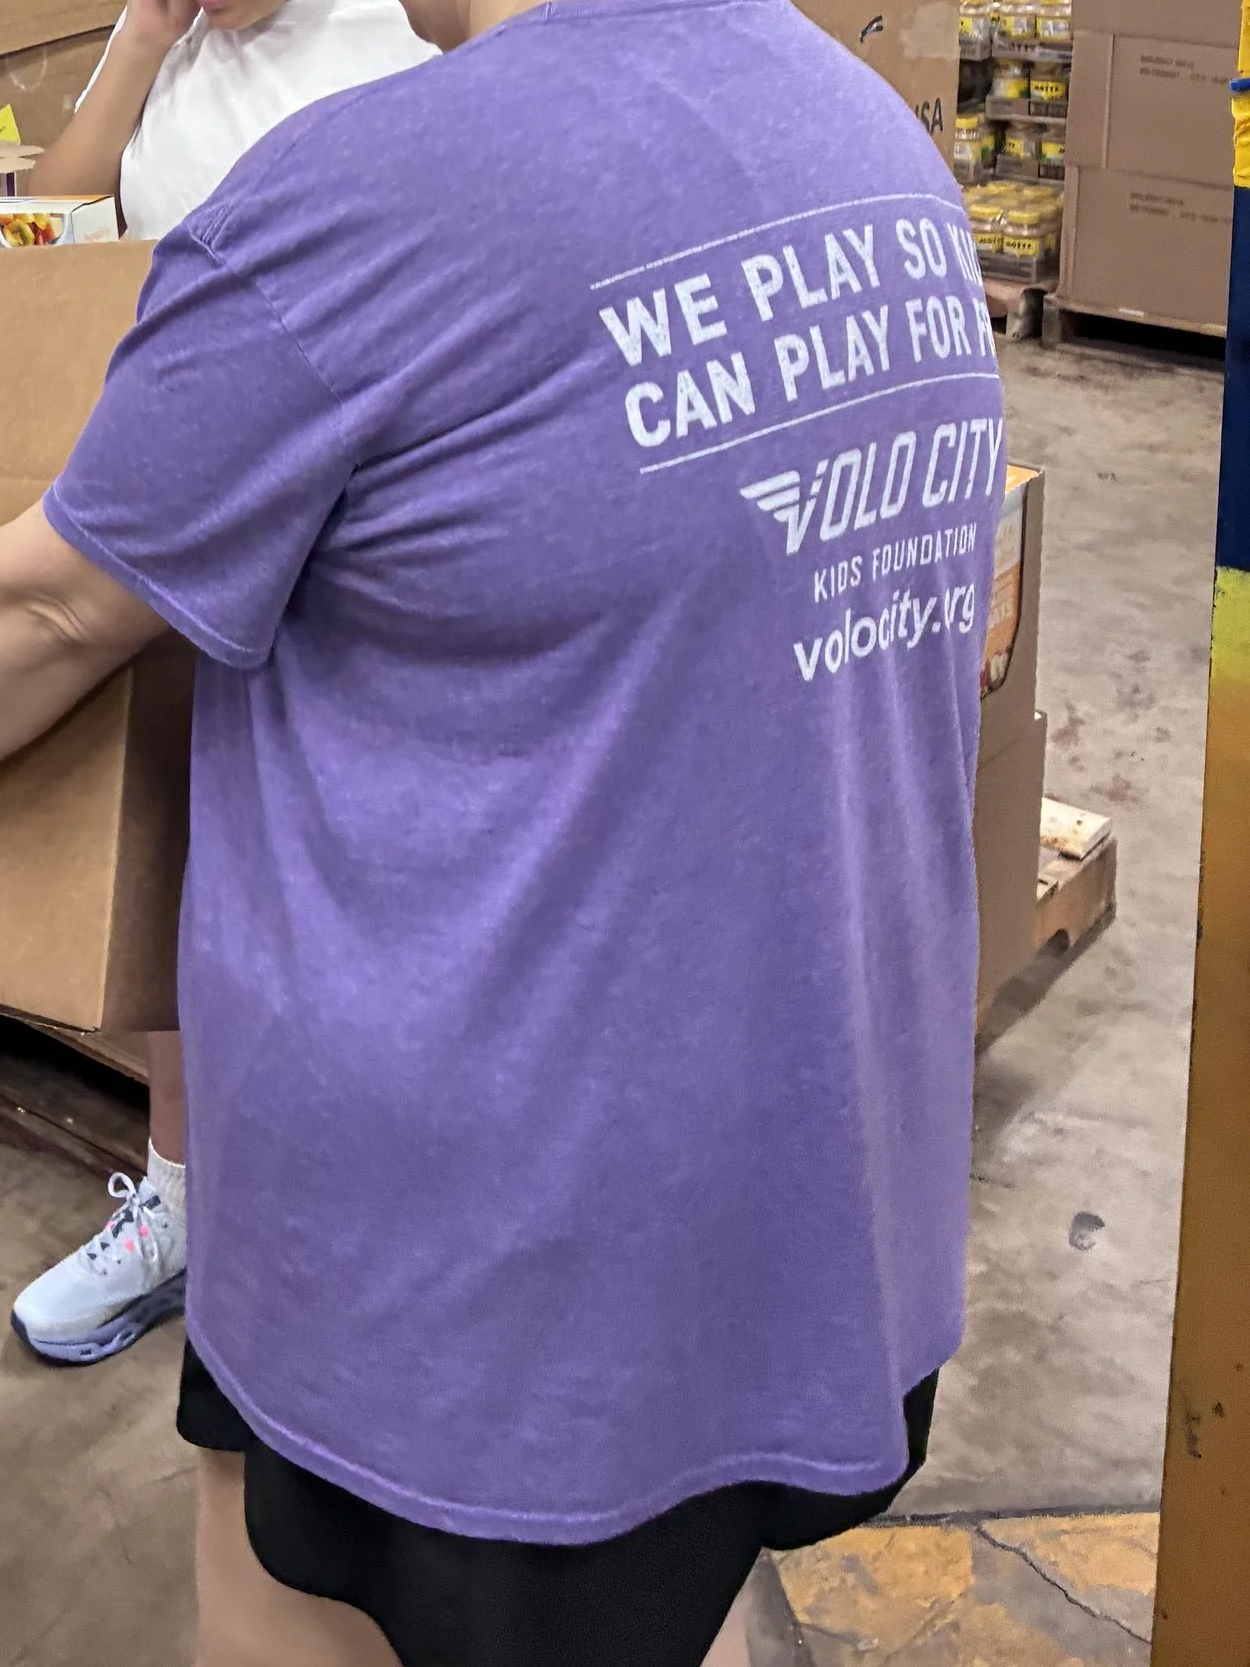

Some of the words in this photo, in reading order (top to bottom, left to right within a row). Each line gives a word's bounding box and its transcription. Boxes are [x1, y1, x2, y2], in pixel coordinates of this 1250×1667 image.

[599, 272, 727, 367] WE
[741, 224, 881, 322] PLAY
[895, 217, 948, 280] SO
[624, 351, 756, 448] CAN
[773, 304, 890, 401] PLAY
[905, 295, 972, 363] FOR
[921, 418, 1003, 508] CITY
[813, 555, 863, 604] KIDS
[872, 522, 977, 582] FOUNDATION
